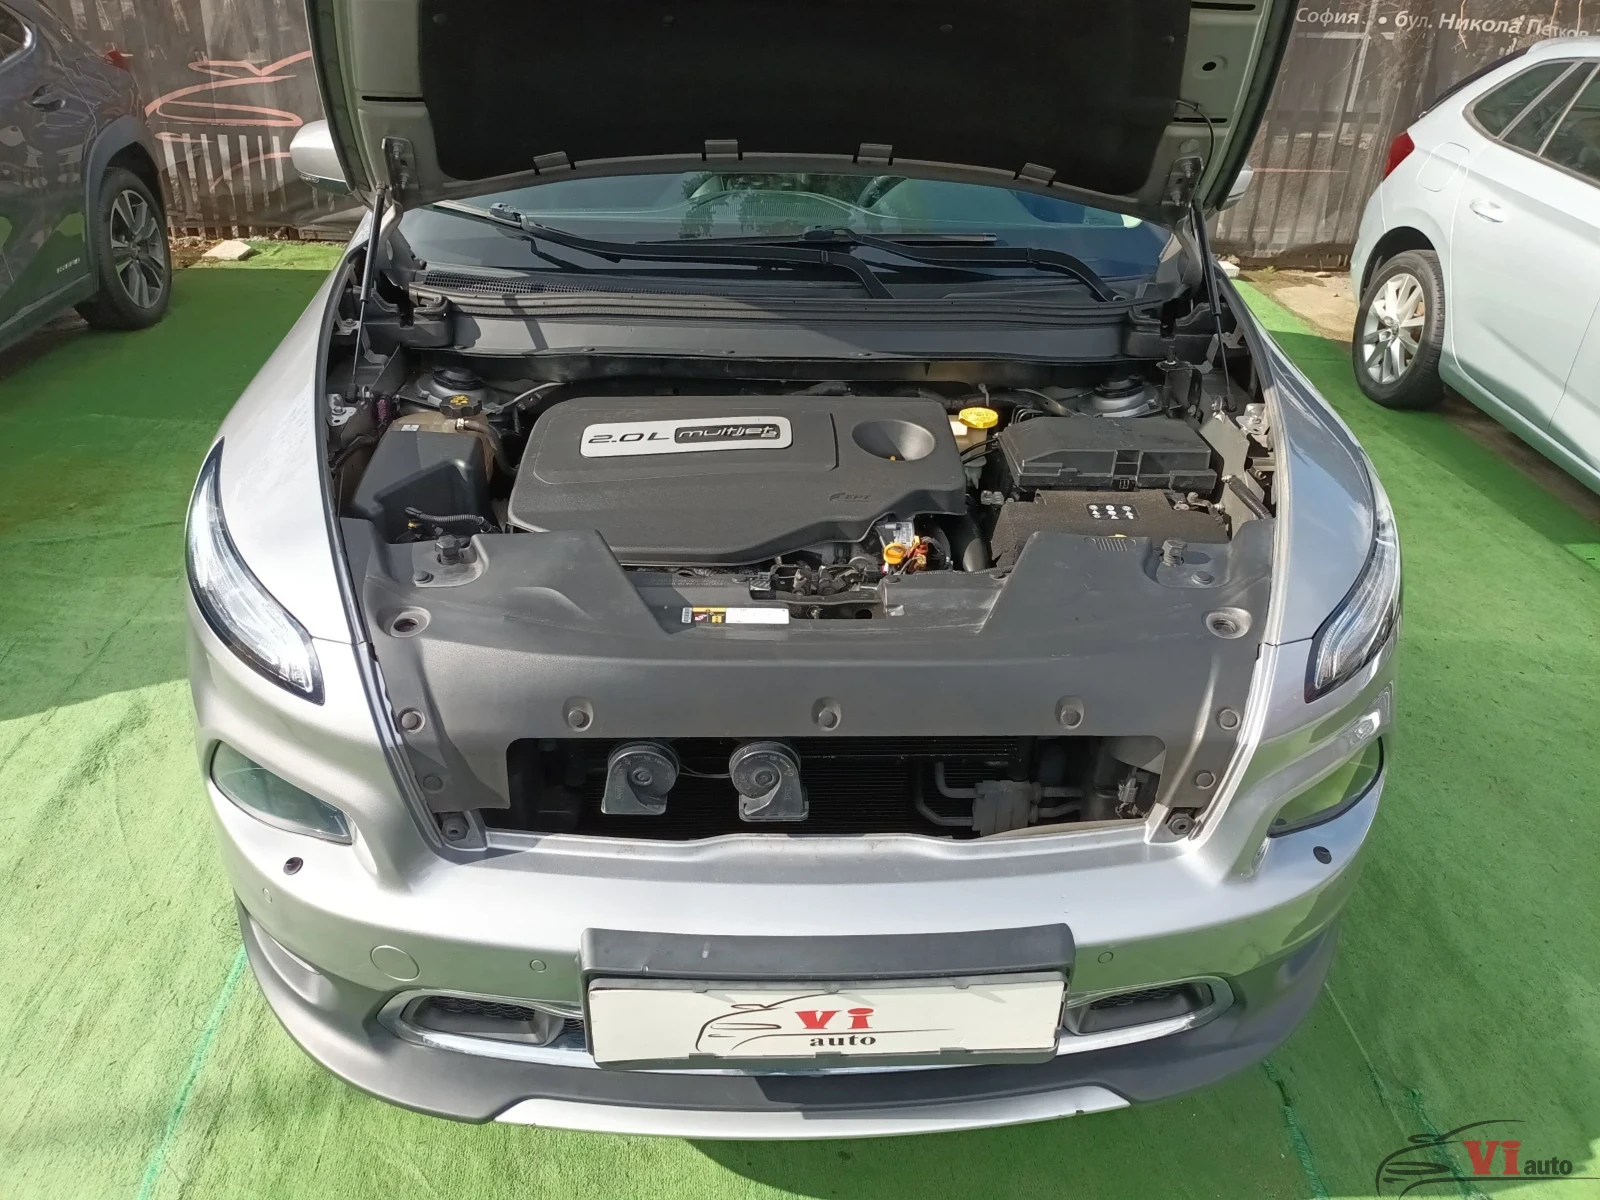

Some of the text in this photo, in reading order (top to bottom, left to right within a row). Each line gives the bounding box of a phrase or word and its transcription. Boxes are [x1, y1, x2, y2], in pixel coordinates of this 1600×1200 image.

[1394, 10, 1433, 32] бул.
[1438, 13, 1522, 35] Никола
[794, 1007, 874, 1030] Vi
[809, 1034, 877, 1047] auto
